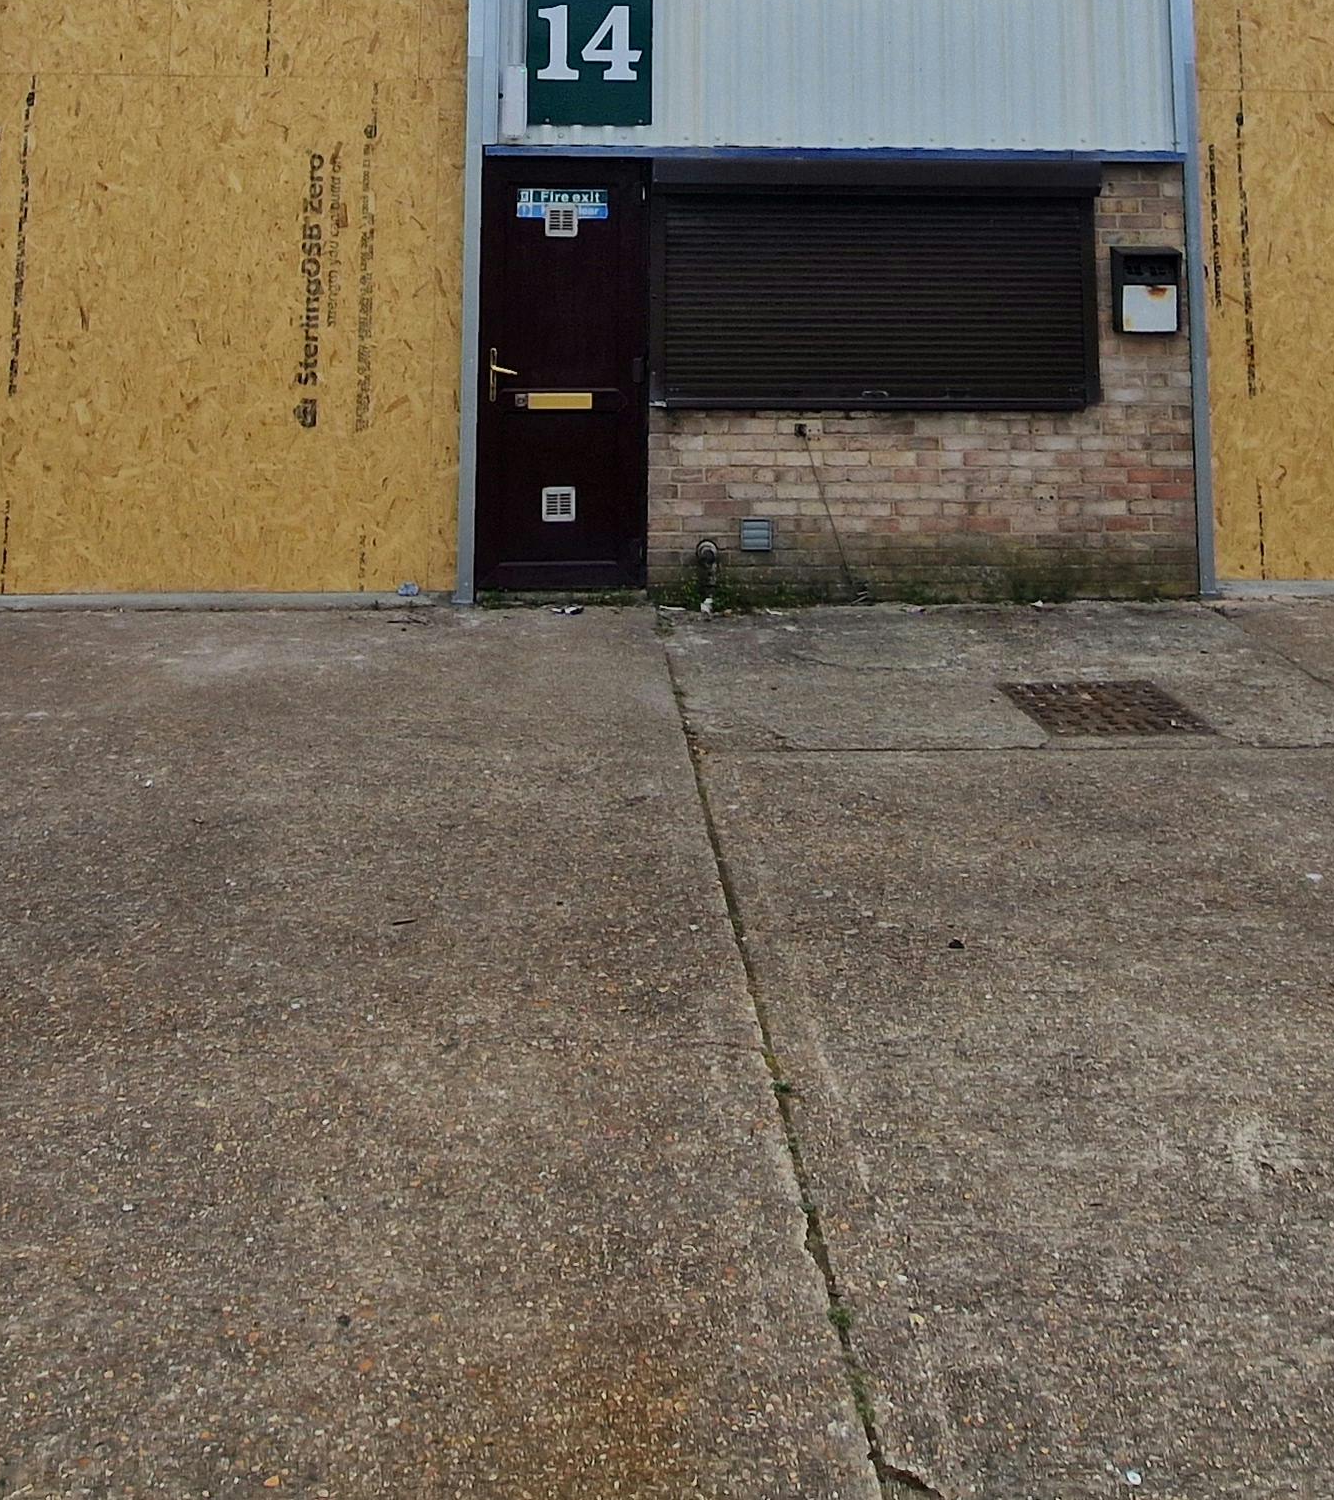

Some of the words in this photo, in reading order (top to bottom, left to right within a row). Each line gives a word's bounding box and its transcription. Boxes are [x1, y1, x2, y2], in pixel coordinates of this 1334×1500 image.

[537, 4, 643, 81] 14
[304, 153, 325, 215] Zero
[541, 191, 569, 202] Fire
[572, 191, 600, 202] exit
